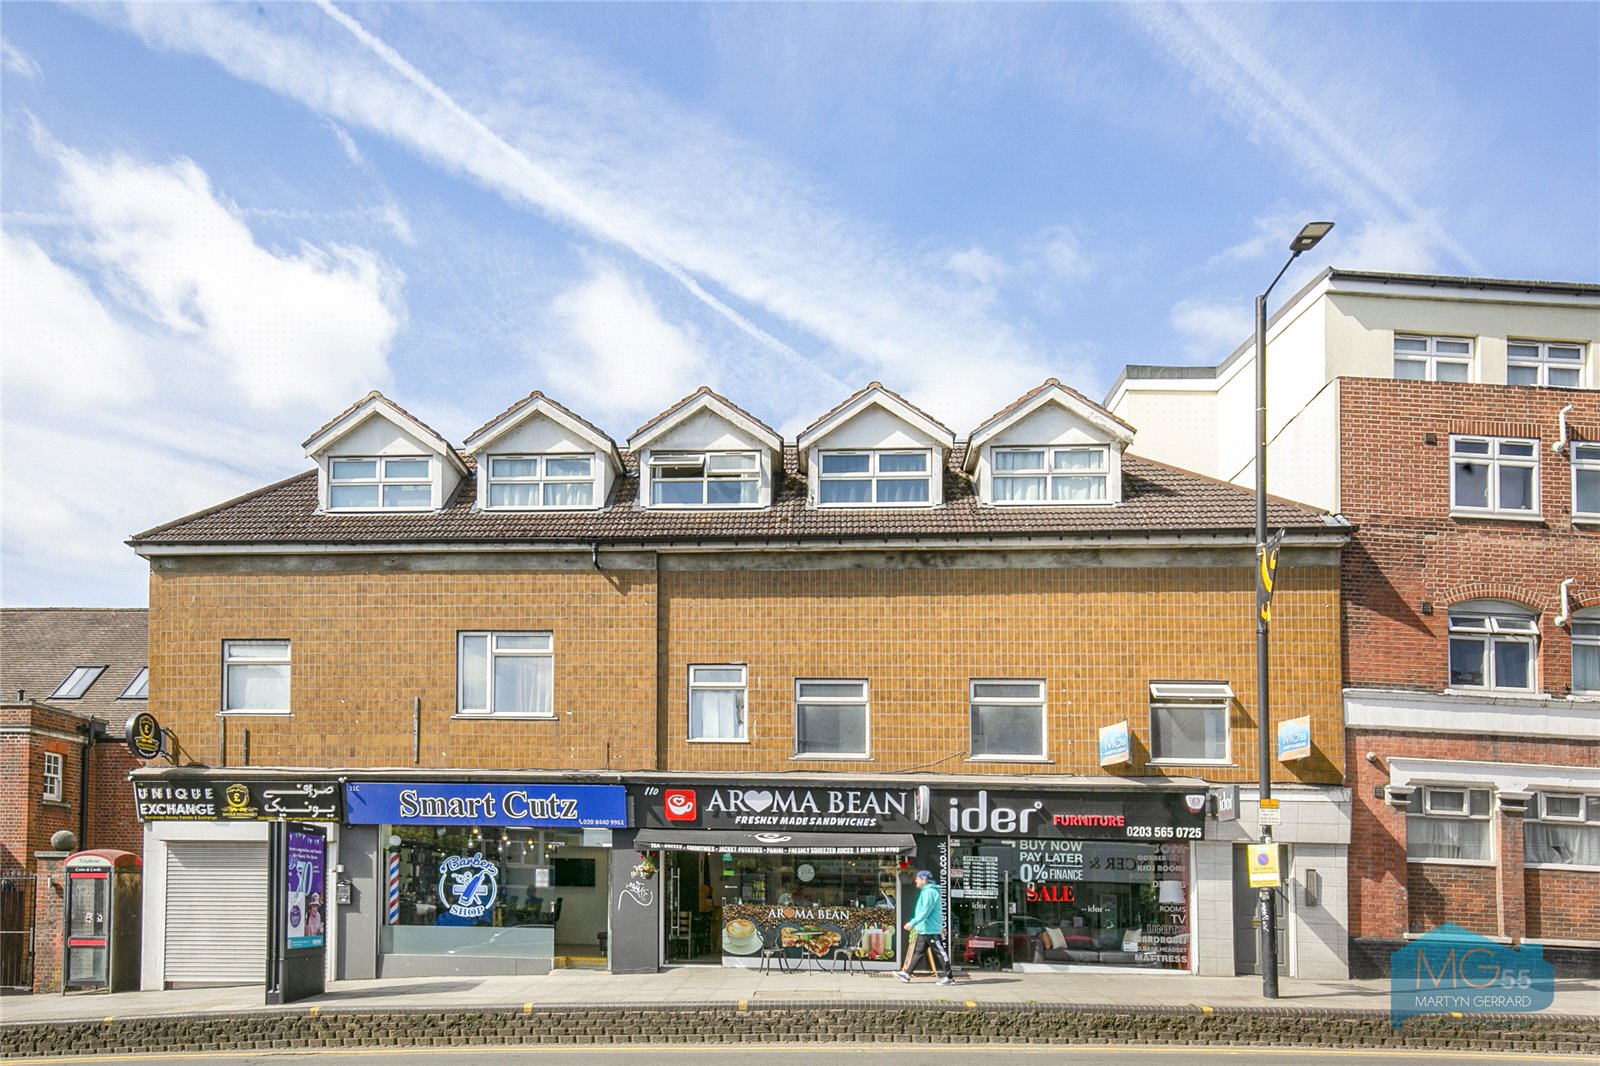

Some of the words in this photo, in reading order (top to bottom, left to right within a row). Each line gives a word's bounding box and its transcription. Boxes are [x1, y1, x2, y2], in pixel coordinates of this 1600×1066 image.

[137, 788, 214, 799] UNIQUE
[140, 803, 216, 815] EXCHANGE
[399, 789, 497, 818] Smart
[502, 791, 578, 820] Cutz
[827, 791, 907, 816] BEAN
[950, 790, 1037, 833] ider
[735, 815, 778, 825] FRESHLY
[779, 816, 808, 826] MADE
[809, 817, 877, 827] SANDWICHES
[1053, 815, 1125, 827] FURNITURE
[1127, 827, 1152, 837] 0203
[1154, 827, 1174, 837] 565
[1176, 827, 1202, 838] 0725
[1020, 840, 1047, 850] BUY
[1050, 841, 1083, 851] NOW
[446, 852, 497, 873] Barber
[1020, 852, 1042, 861] PAY
[1045, 853, 1083, 863] LATER
[1020, 863, 1048, 883] 0%
[1050, 868, 1083, 880] FINANCE
[1026, 885, 1075, 902] SALE
[449, 904, 485, 917] SHOP
[818, 910, 850, 920] BEAN
[1171, 914, 1186, 924] TV
[1147, 924, 1186, 934] UNITS
[1135, 954, 1188, 963] MATTRESS
